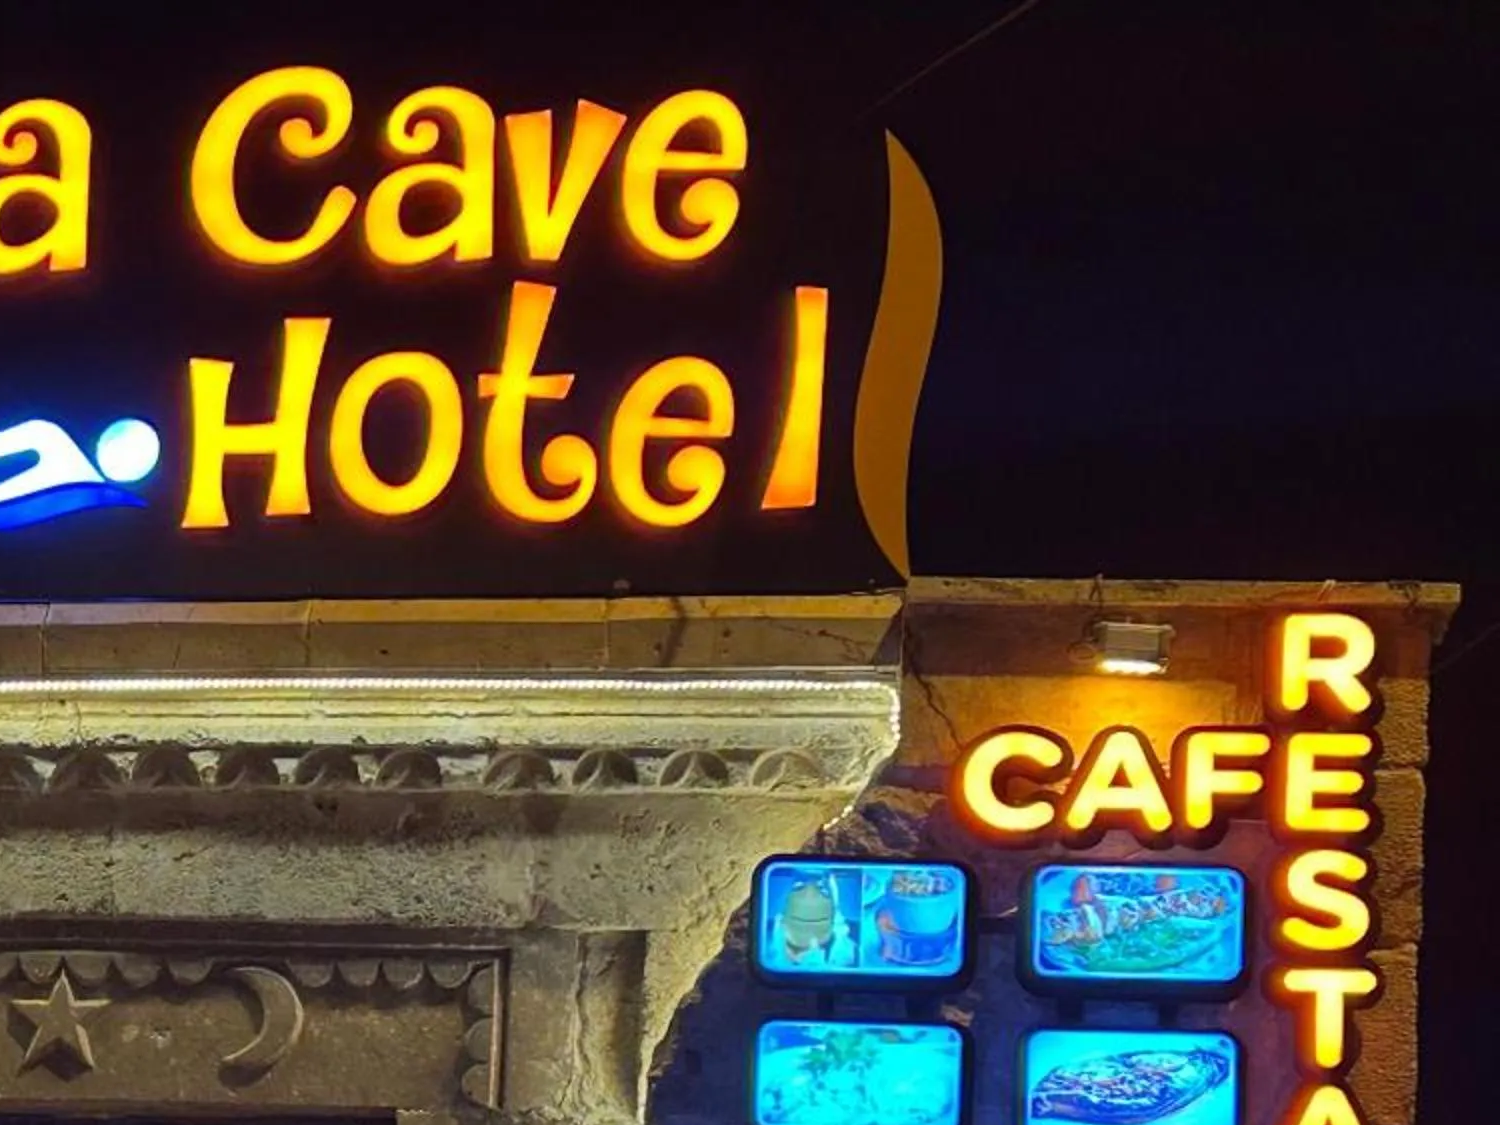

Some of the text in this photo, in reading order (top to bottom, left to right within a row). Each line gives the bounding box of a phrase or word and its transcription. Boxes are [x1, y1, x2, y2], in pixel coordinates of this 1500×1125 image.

[190, 65, 748, 266] Cave
[180, 280, 829, 530] Hotel
[962, 731, 1373, 834] CAFE
